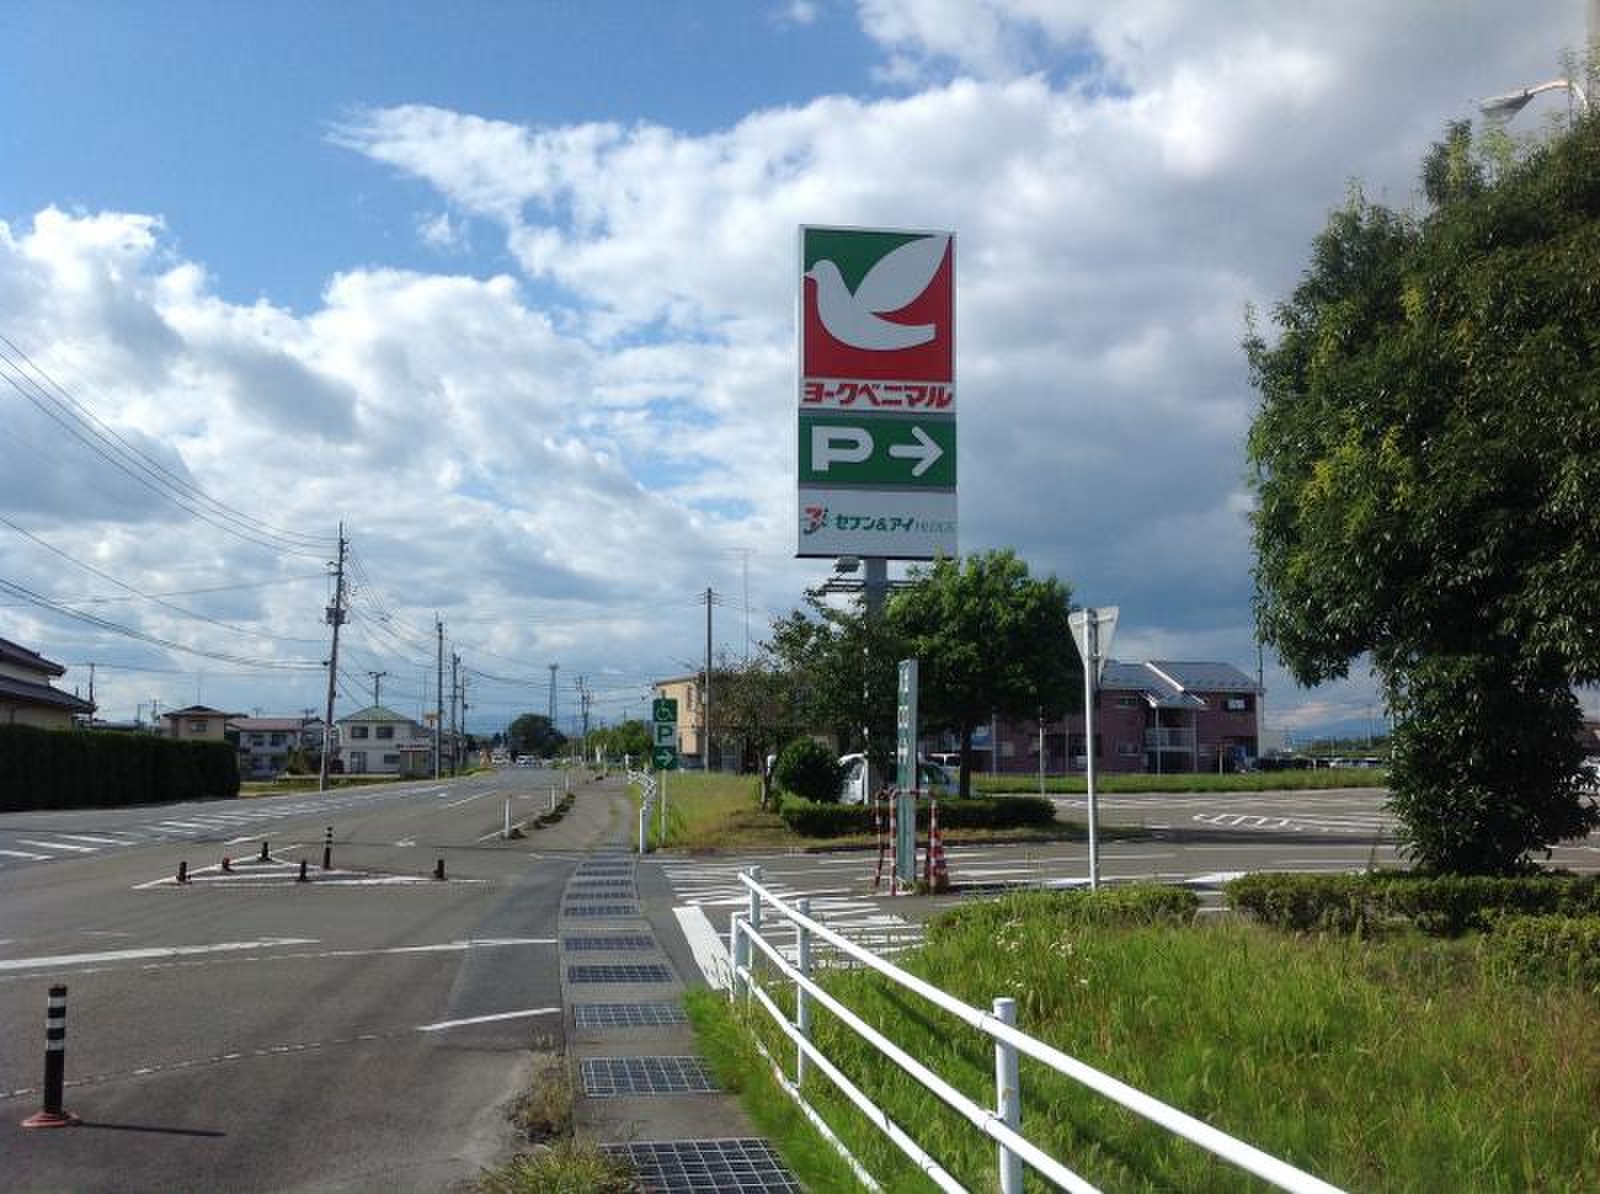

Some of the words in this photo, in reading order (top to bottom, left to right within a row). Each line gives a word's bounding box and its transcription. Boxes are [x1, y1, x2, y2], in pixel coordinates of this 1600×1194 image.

[803, 382, 953, 408] ヨークベニマル
[812, 425, 875, 472] P
